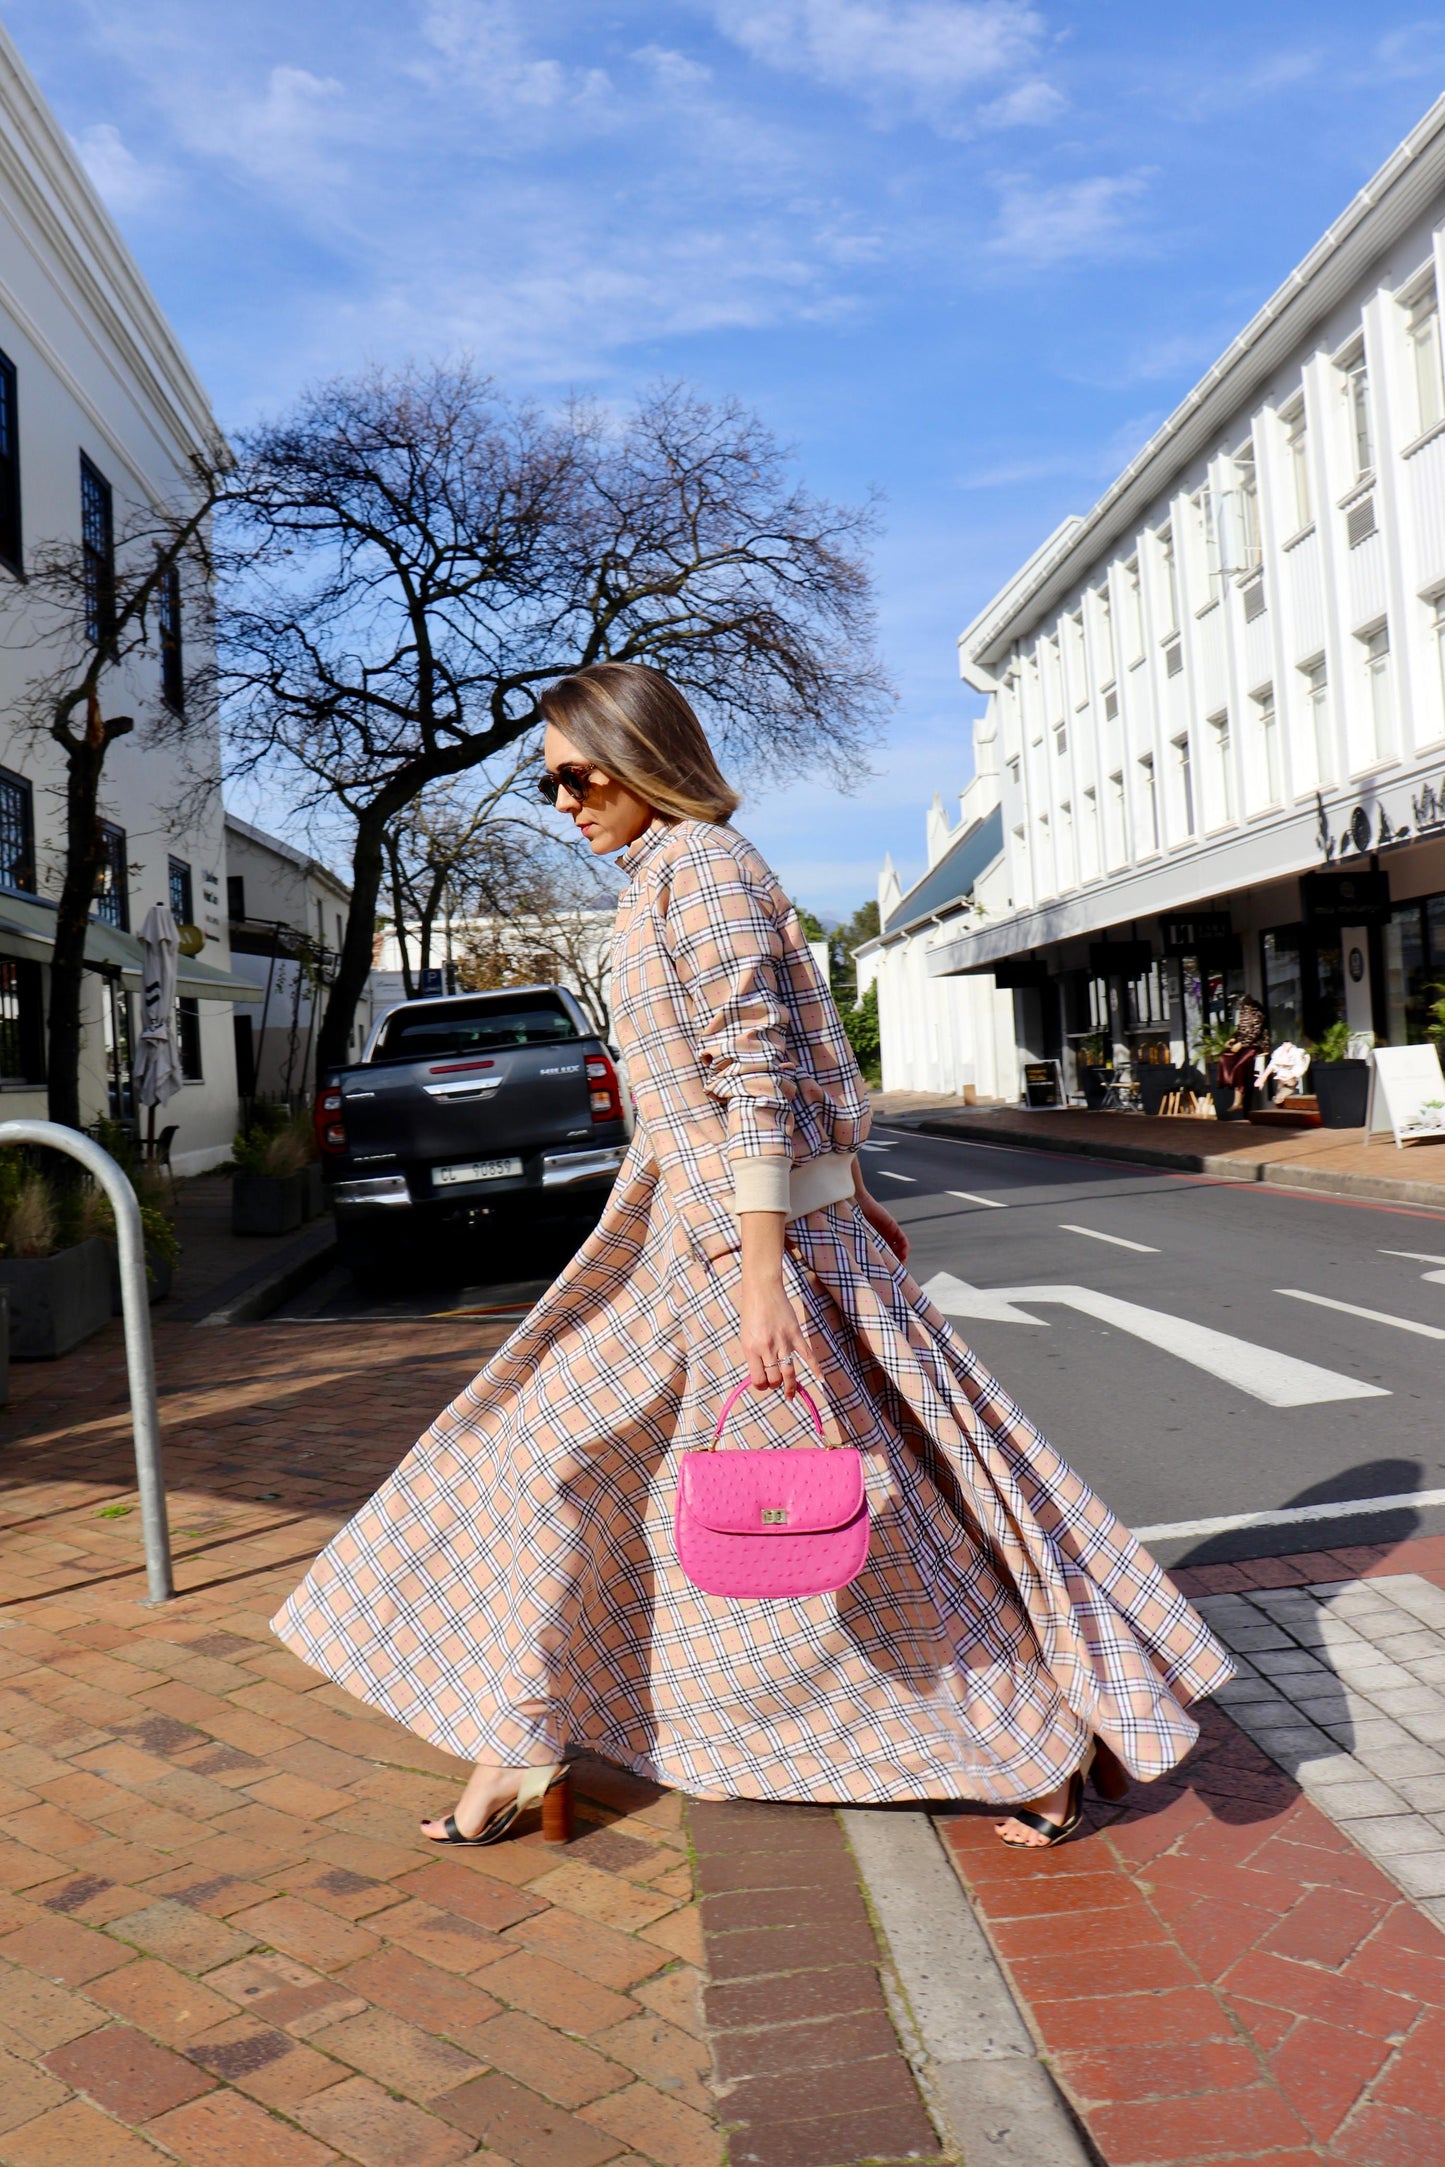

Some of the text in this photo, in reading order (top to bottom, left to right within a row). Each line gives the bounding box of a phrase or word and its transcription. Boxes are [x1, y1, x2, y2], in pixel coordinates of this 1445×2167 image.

[427, 971, 438, 983] P
[440, 1159, 512, 1182] CL 90859
